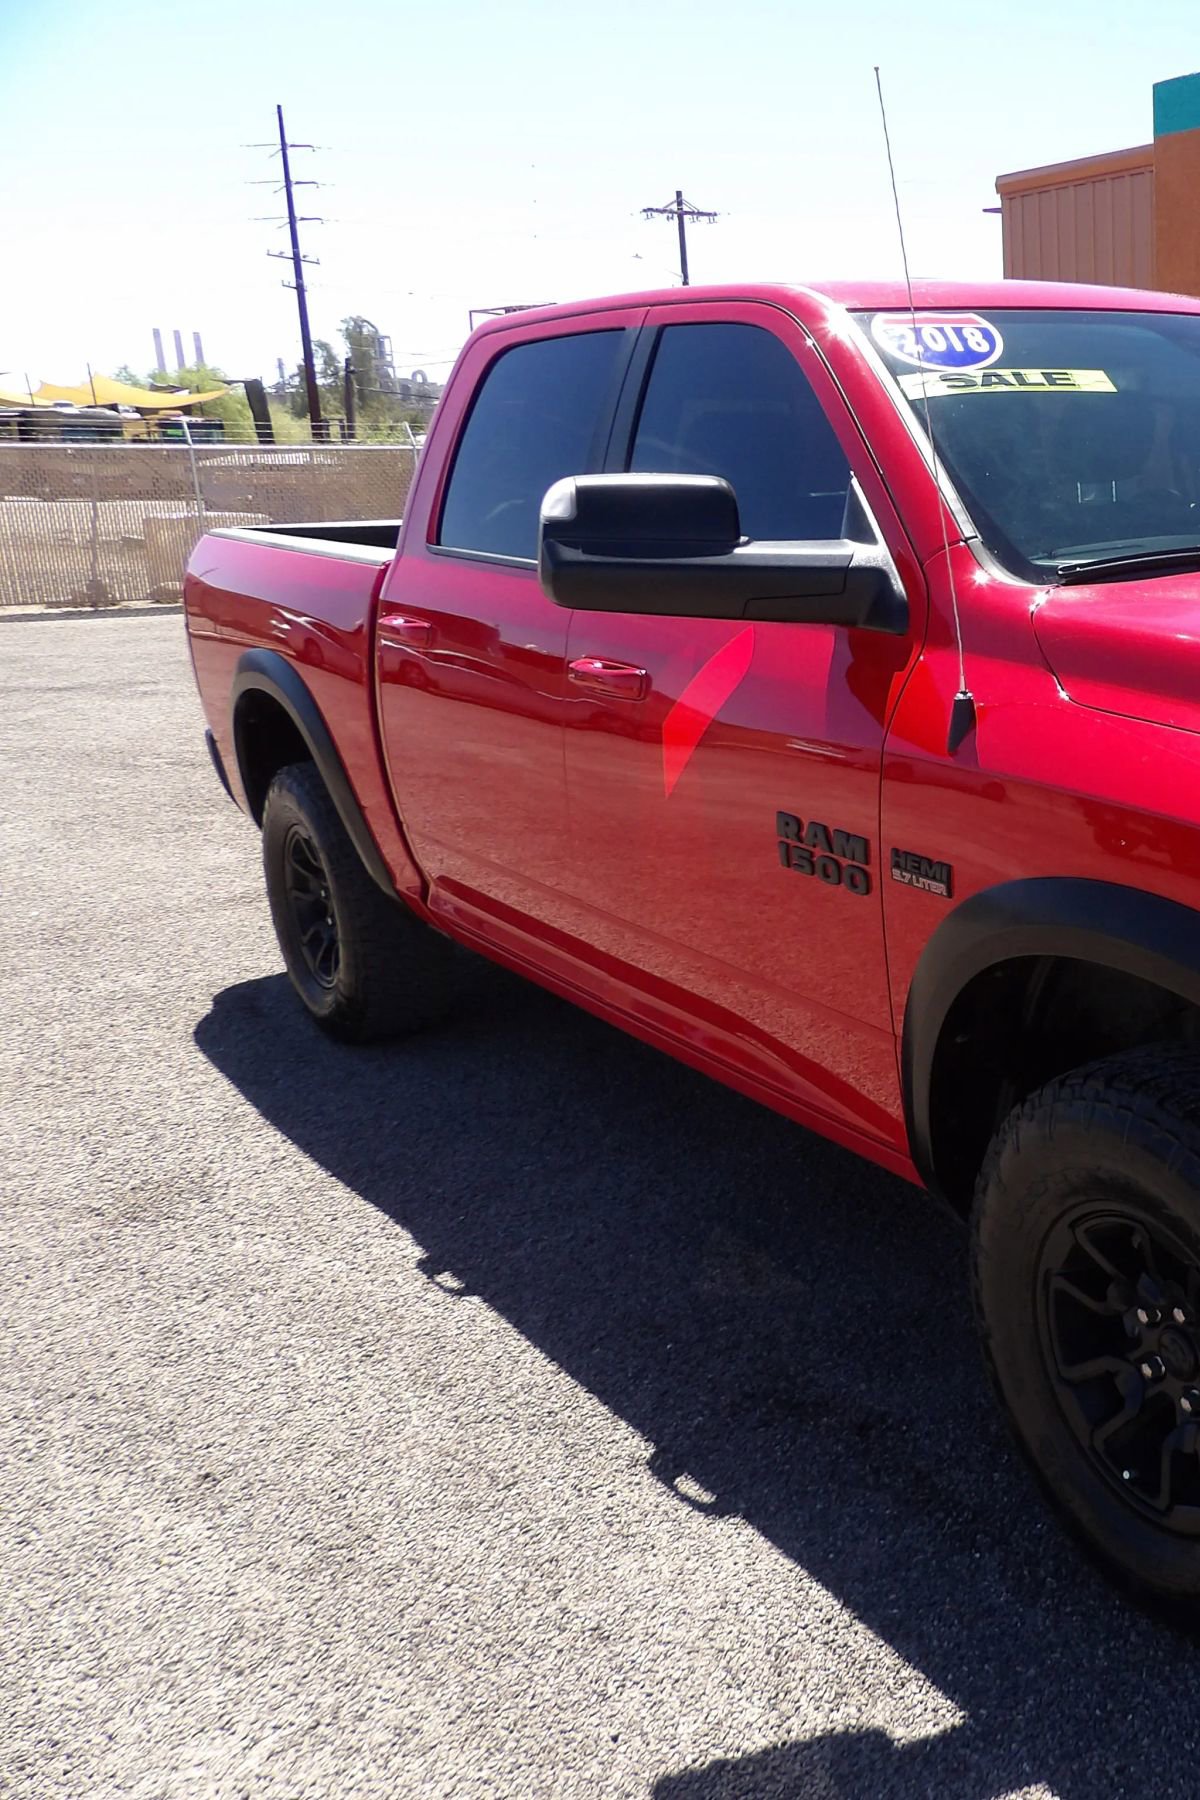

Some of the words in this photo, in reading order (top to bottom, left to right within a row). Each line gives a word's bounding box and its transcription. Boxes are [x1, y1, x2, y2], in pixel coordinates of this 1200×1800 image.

[885, 326, 990, 357] 2018
[938, 371, 1078, 390] SALE
[776, 811, 869, 865] RAM
[778, 841, 870, 896] 1500
[891, 848, 952, 882] HEMI
[912, 874, 948, 896] LITER
